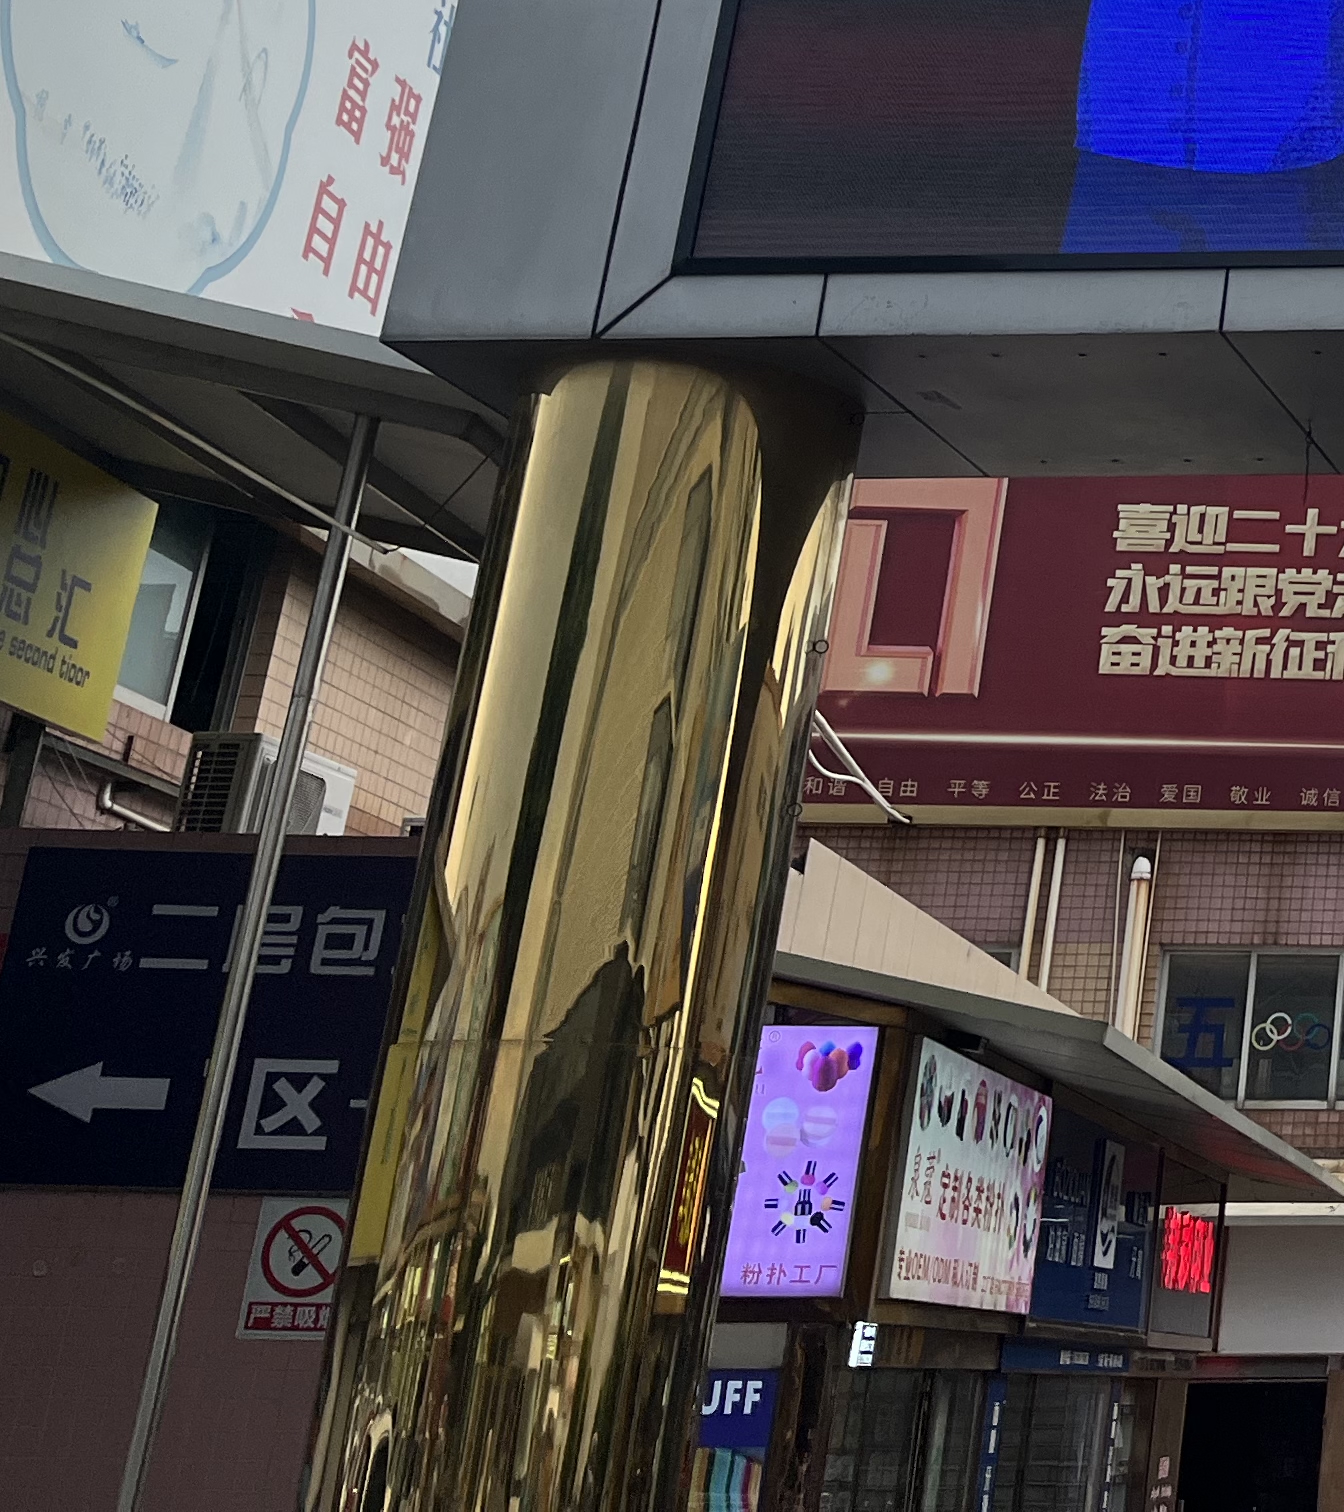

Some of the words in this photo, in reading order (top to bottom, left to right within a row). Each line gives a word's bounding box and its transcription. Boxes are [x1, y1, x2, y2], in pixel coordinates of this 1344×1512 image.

[302, 174, 393, 316] 自由
[804, 776, 847, 796] 和谐
[878, 778, 919, 798] 自由
[947, 779, 992, 799] 平等
[1018, 780, 1062, 801] 公正
[1089, 781, 1132, 802] 法治
[1159, 783, 1202, 803] 爱国
[1229, 785, 1271, 805] 敬业
[1300, 787, 1342, 807] 诚信
[26, 946, 133, 973] 兴发广场
[139, 905, 400, 976] 二层包
[1176, 997, 1235, 1068] 五
[236, 1057, 362, 1150] 区
[740, 1261, 838, 1285] 粉扑工厂
